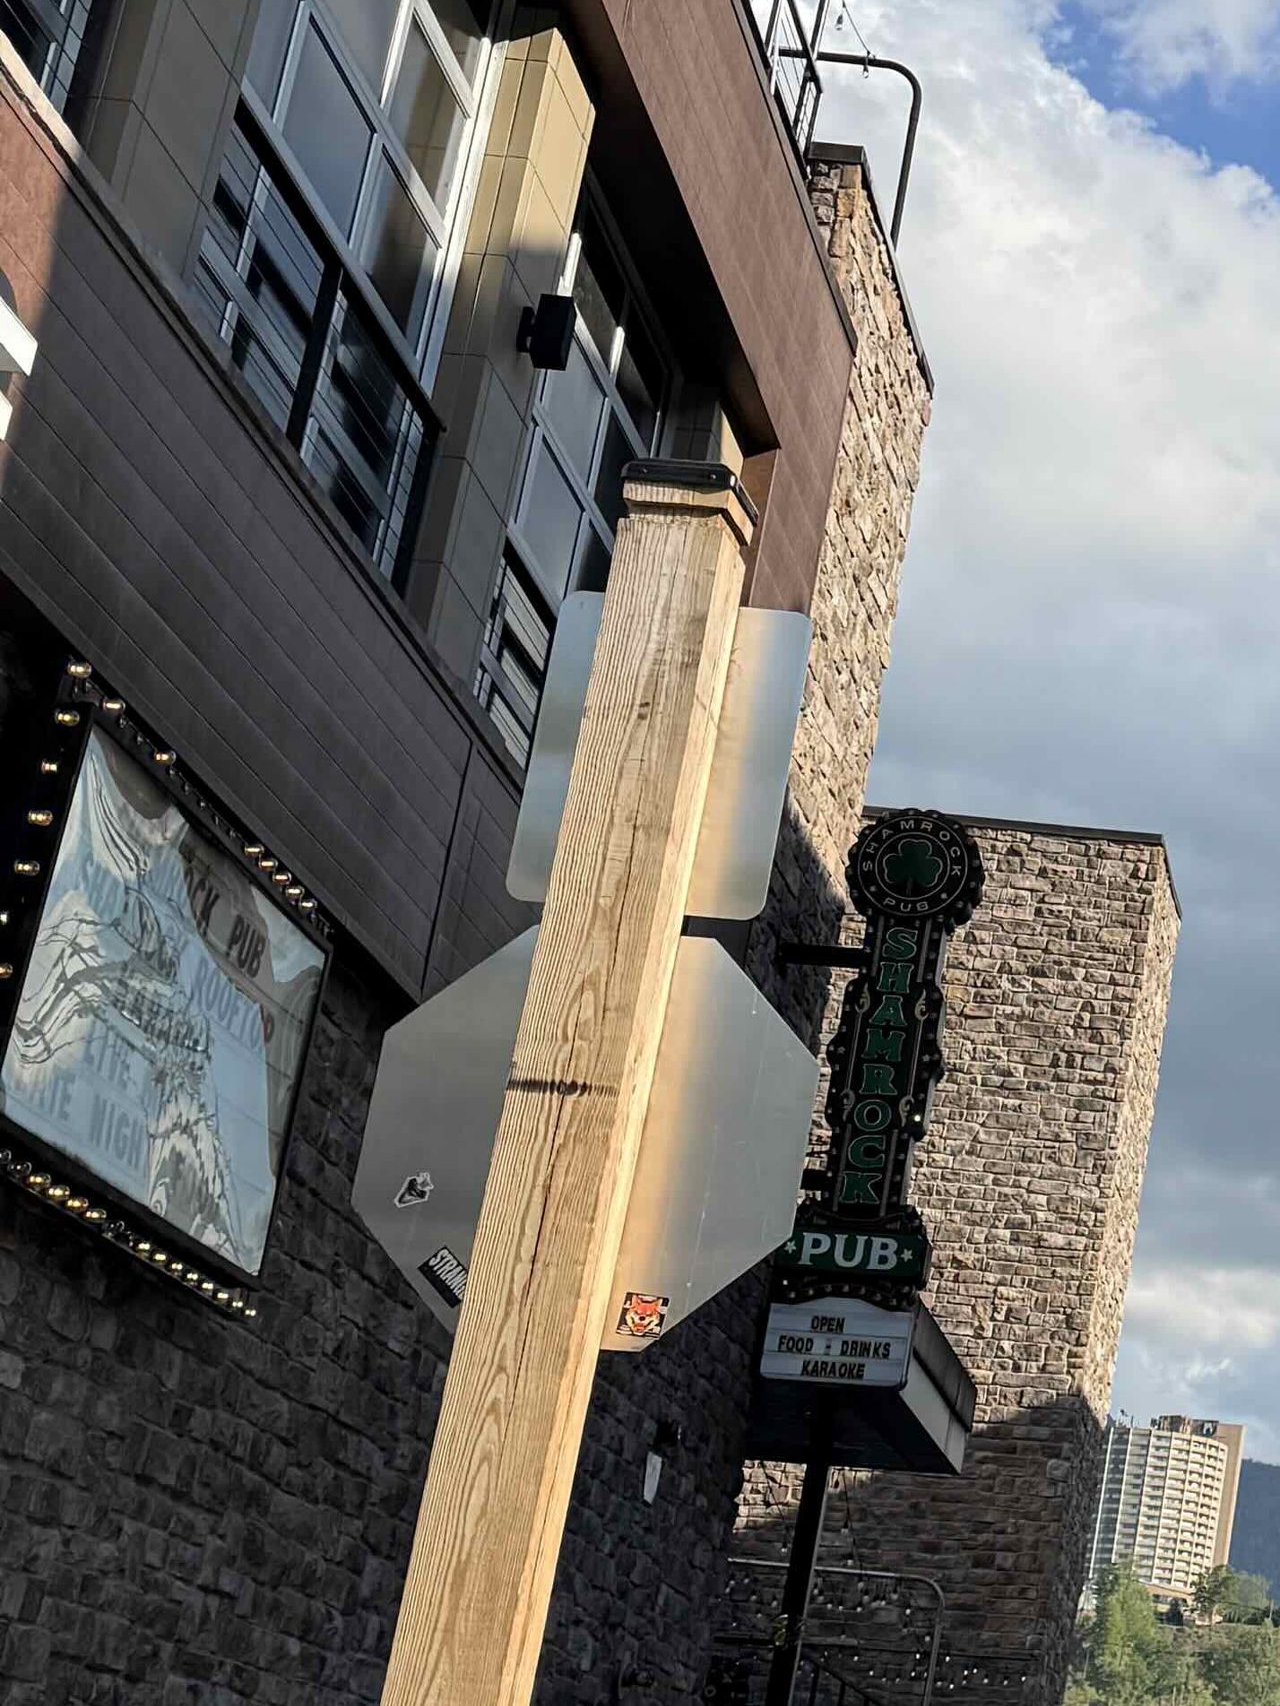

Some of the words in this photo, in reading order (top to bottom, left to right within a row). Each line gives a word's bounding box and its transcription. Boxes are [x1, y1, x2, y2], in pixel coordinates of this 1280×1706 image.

[863, 820, 962, 876] SHAMROCK
[883, 897, 929, 912] PUB
[231, 914, 266, 980] PUB
[840, 927, 918, 1204] SHAMROCK
[88, 1092, 143, 1171] NIGH
[798, 1232, 899, 1270] PUB
[811, 1315, 846, 1333] OPEN
[777, 1335, 814, 1354] FOOD
[840, 1340, 892, 1359] DRINKS
[801, 1359, 866, 1380] KARAOKE
